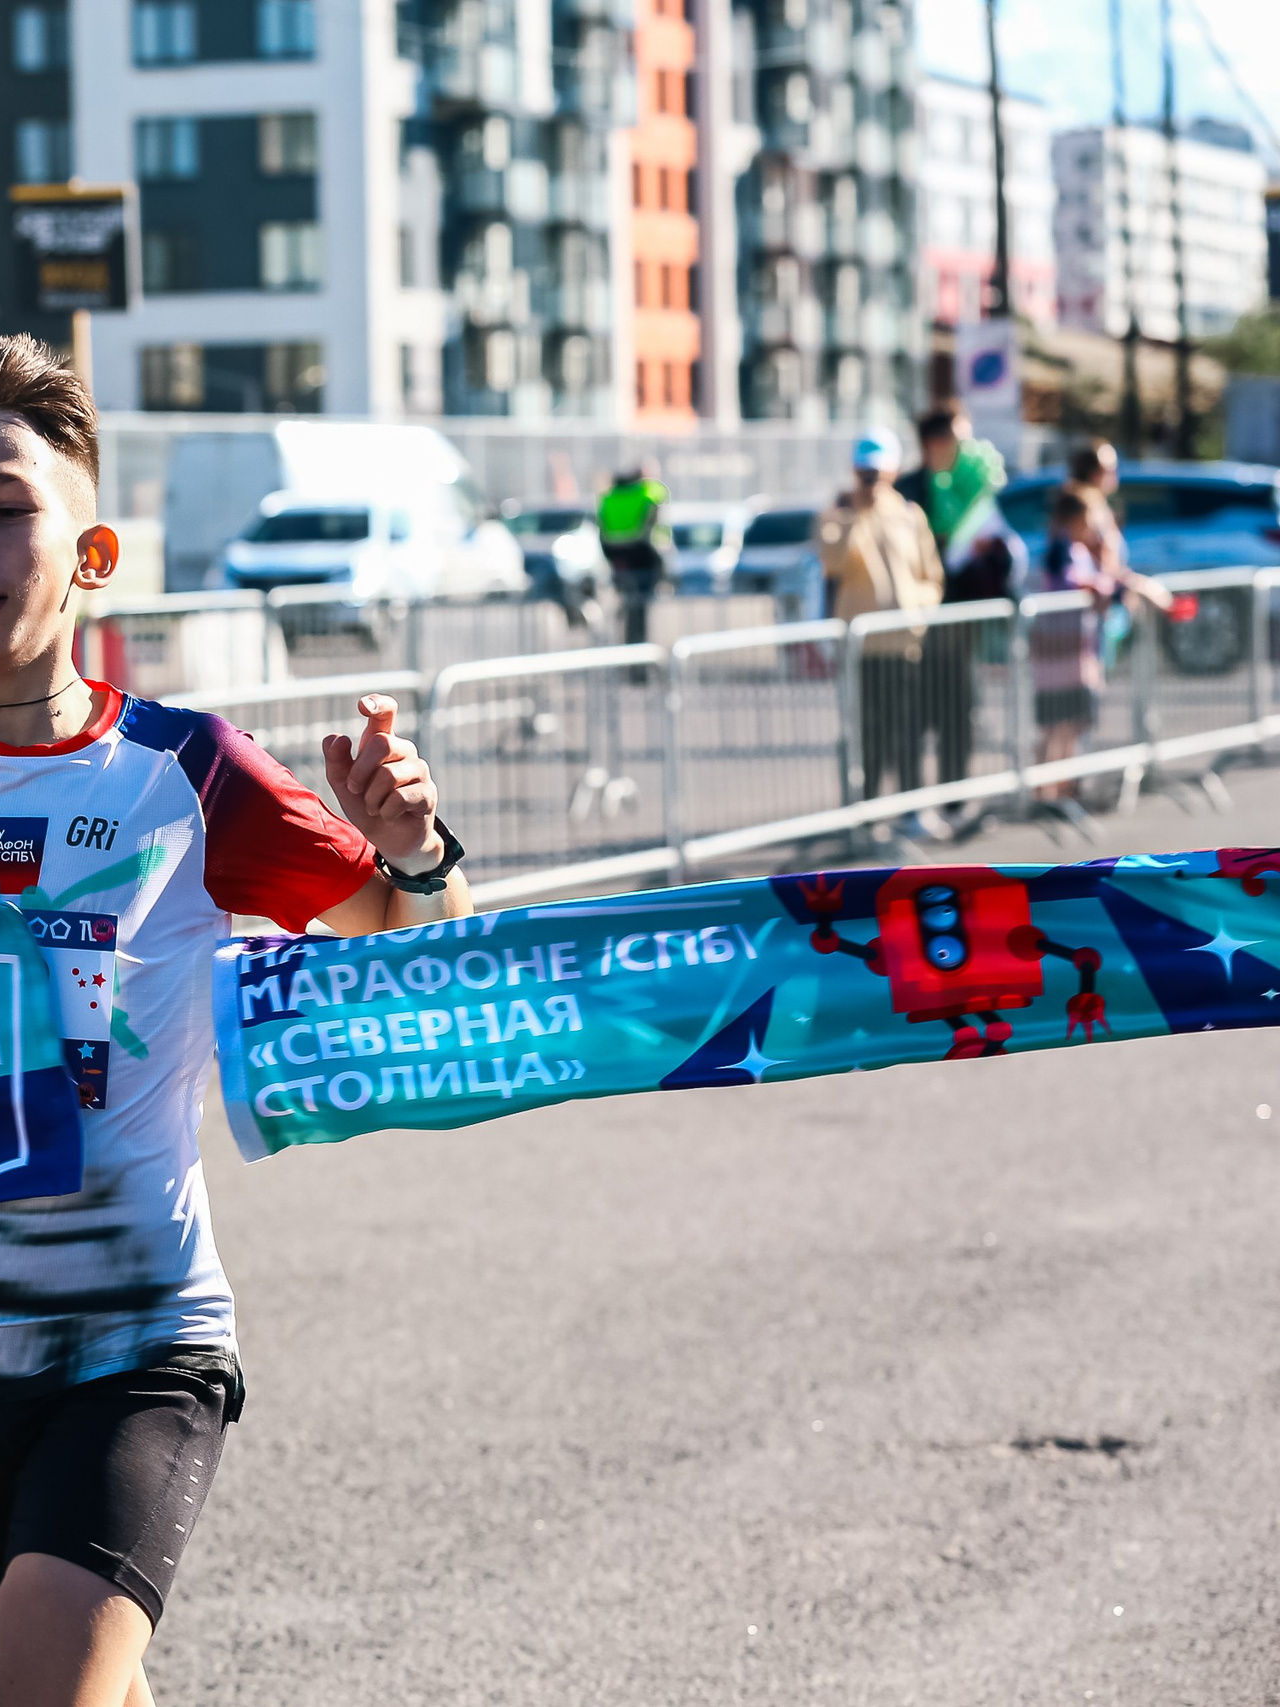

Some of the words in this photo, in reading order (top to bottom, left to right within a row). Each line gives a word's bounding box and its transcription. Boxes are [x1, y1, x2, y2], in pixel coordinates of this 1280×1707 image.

[65, 814, 120, 851] GRi
[241, 941, 583, 1021] МАРАФОНЕ
[248, 993, 583, 1068] «СЕВЕРНАЯ
[253, 1050, 587, 1118] СТОЛИЦА»
